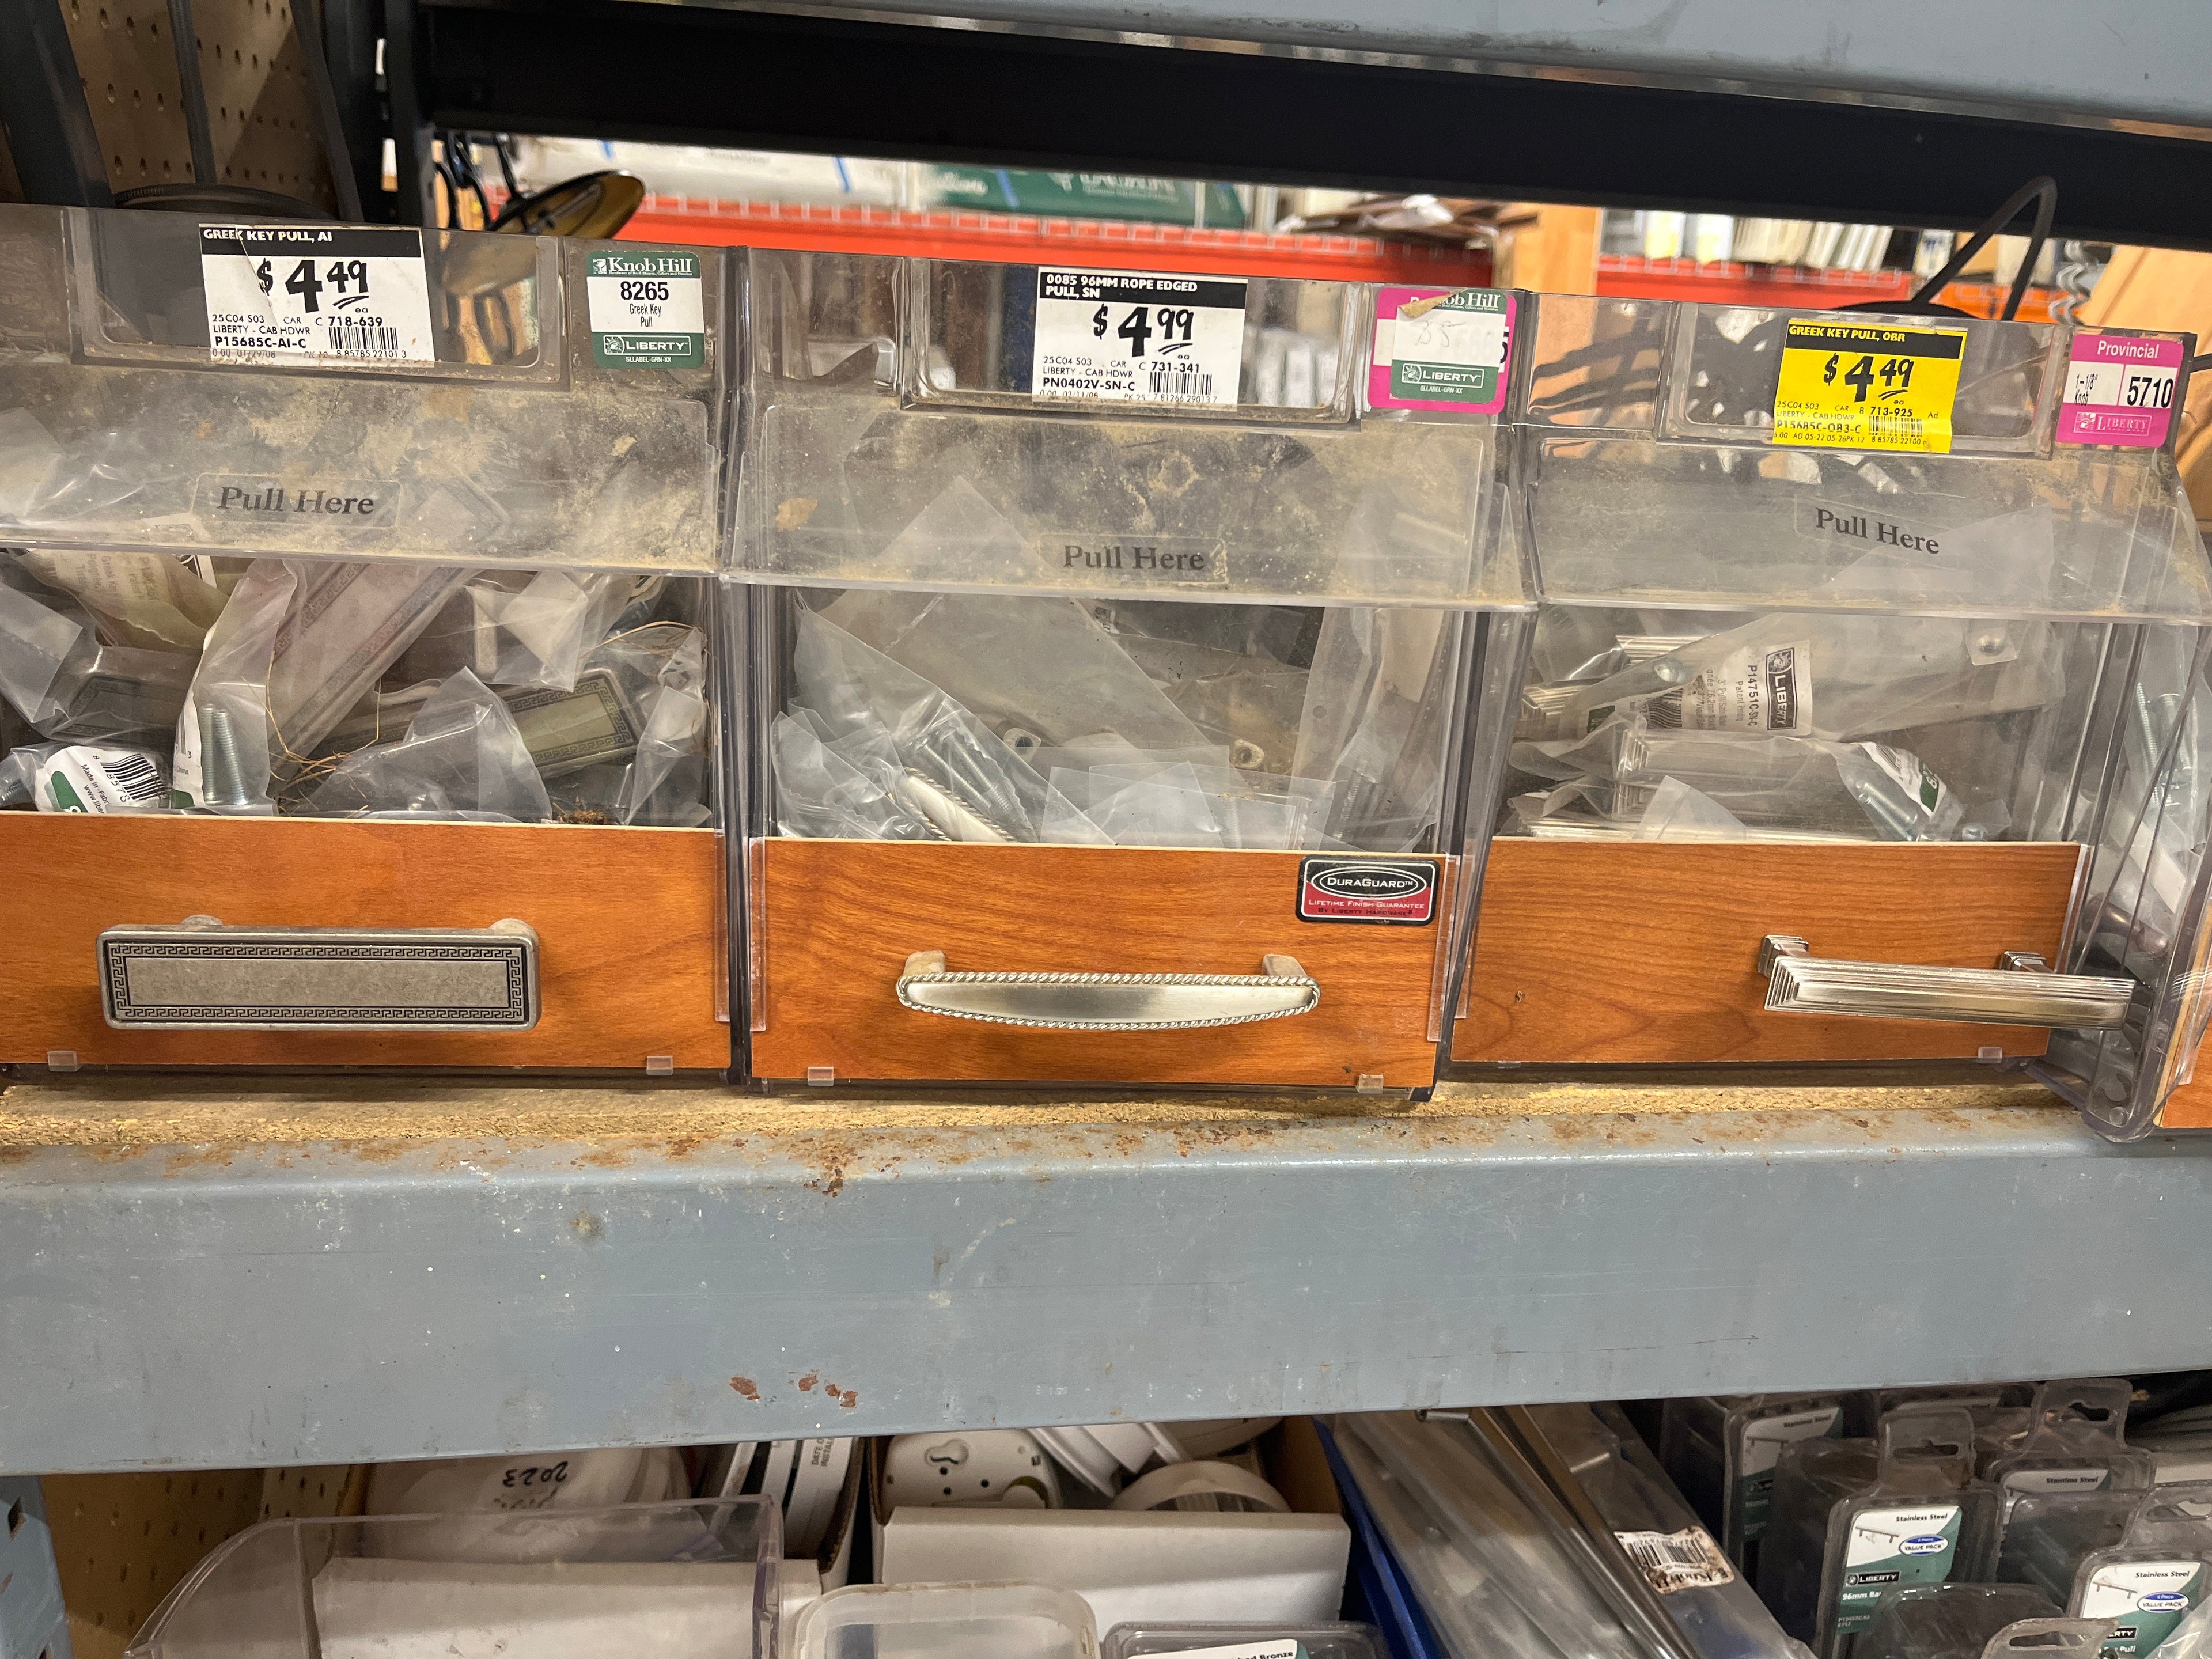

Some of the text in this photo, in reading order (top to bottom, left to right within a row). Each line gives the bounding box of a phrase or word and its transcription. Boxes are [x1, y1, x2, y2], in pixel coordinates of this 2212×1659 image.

[203, 229, 243, 240] GREEK
[247, 230, 273, 241] KEY
[279, 231, 315, 243] PULL,
[608, 257, 657, 272] Knob
[620, 281, 669, 301] 8265
[1046, 274, 1198, 292] 0085 96MM ROPE EDGED
[1046, 286, 1100, 299] PULL, SN
[630, 303, 662, 317] Greek Key
[248, 315, 264, 323] S03
[283, 316, 301, 324] CAR
[316, 317, 323, 326] C
[328, 316, 382, 327] 718-639
[641, 316, 653, 327] Pull
[213, 325, 311, 335] LIBERTY CAB HDWR
[1789, 325, 1824, 337] GREEK
[1827, 328, 1850, 338] KEY
[1851, 330, 1880, 342] PULL,
[2097, 340, 2160, 358] Provincial
[1043, 367, 1133, 378] LIBERTY CAB HDWR
[1075, 357, 1092, 366] S03
[1139, 362, 1146, 370] C
[1152, 362, 1200, 373] 731-341
[2074, 389, 2089, 406] Knob
[2127, 376, 2173, 408] 5710
[1805, 402, 1819, 410] S03
[1870, 406, 1913, 418] 713-925
[2096, 416, 2147, 430] LIBERTY
[217, 486, 374, 515] Pull Here
[1815, 507, 1940, 555] Pull Here
[1063, 544, 1204, 571] Pull Here
[1735, 681, 1744, 704] Patent
[1774, 675, 1787, 725] LIBERTY
[81, 764, 94, 782] Made
[1309, 899, 1344, 907] LIFETIME
[1376, 902, 1425, 910] GUARANTEE
[1859, 1573, 1896, 1583] LIBERTY
[1843, 1592, 1868, 1601] 96mm
